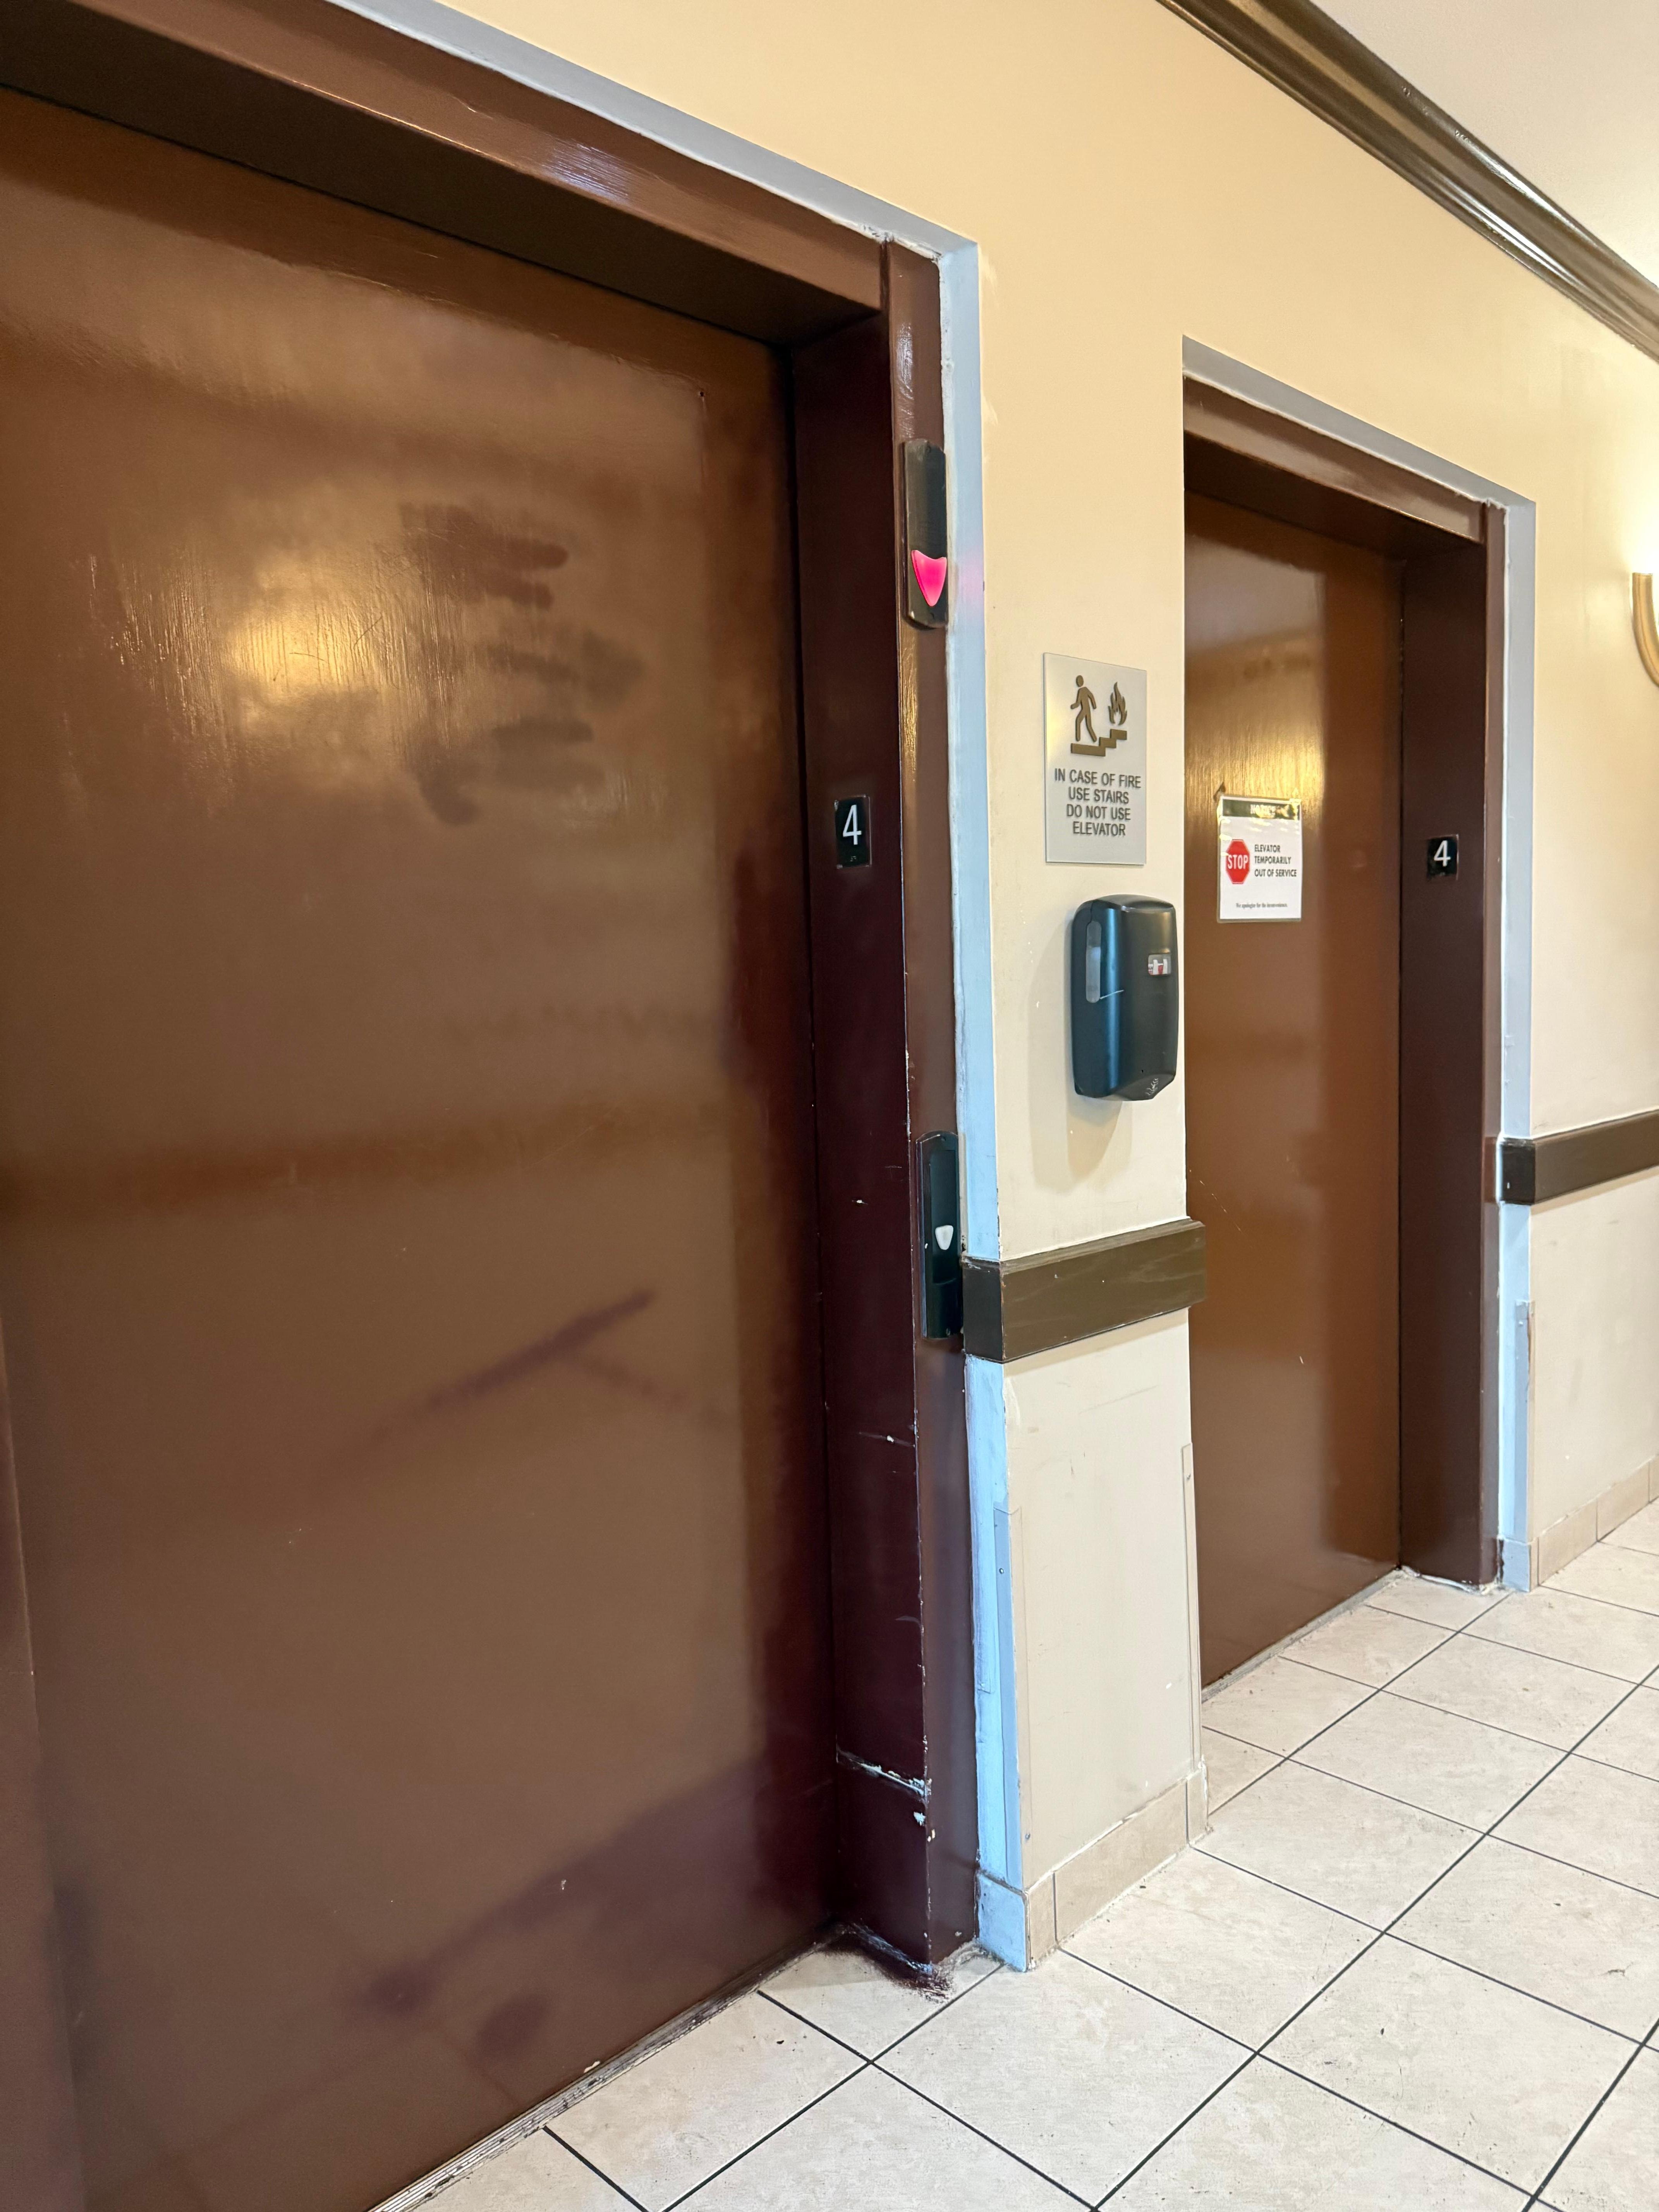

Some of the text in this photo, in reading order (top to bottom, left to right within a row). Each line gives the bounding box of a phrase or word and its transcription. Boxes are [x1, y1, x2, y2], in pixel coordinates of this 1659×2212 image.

[1054, 768, 1141, 788] IN CASE OF FIRE
[1068, 787, 1129, 804] USE STAIRS
[1066, 804, 1131, 821] DO NOT USE
[843, 804, 862, 845] 4
[1073, 821, 1126, 836] ELEVATOR
[1254, 844, 1281, 853] ELEVATOR
[1434, 840, 1451, 867] 4
[1227, 854, 1249, 869] STOP
[1254, 869, 1266, 877] OUT
[1267, 869, 1274, 877] OF
